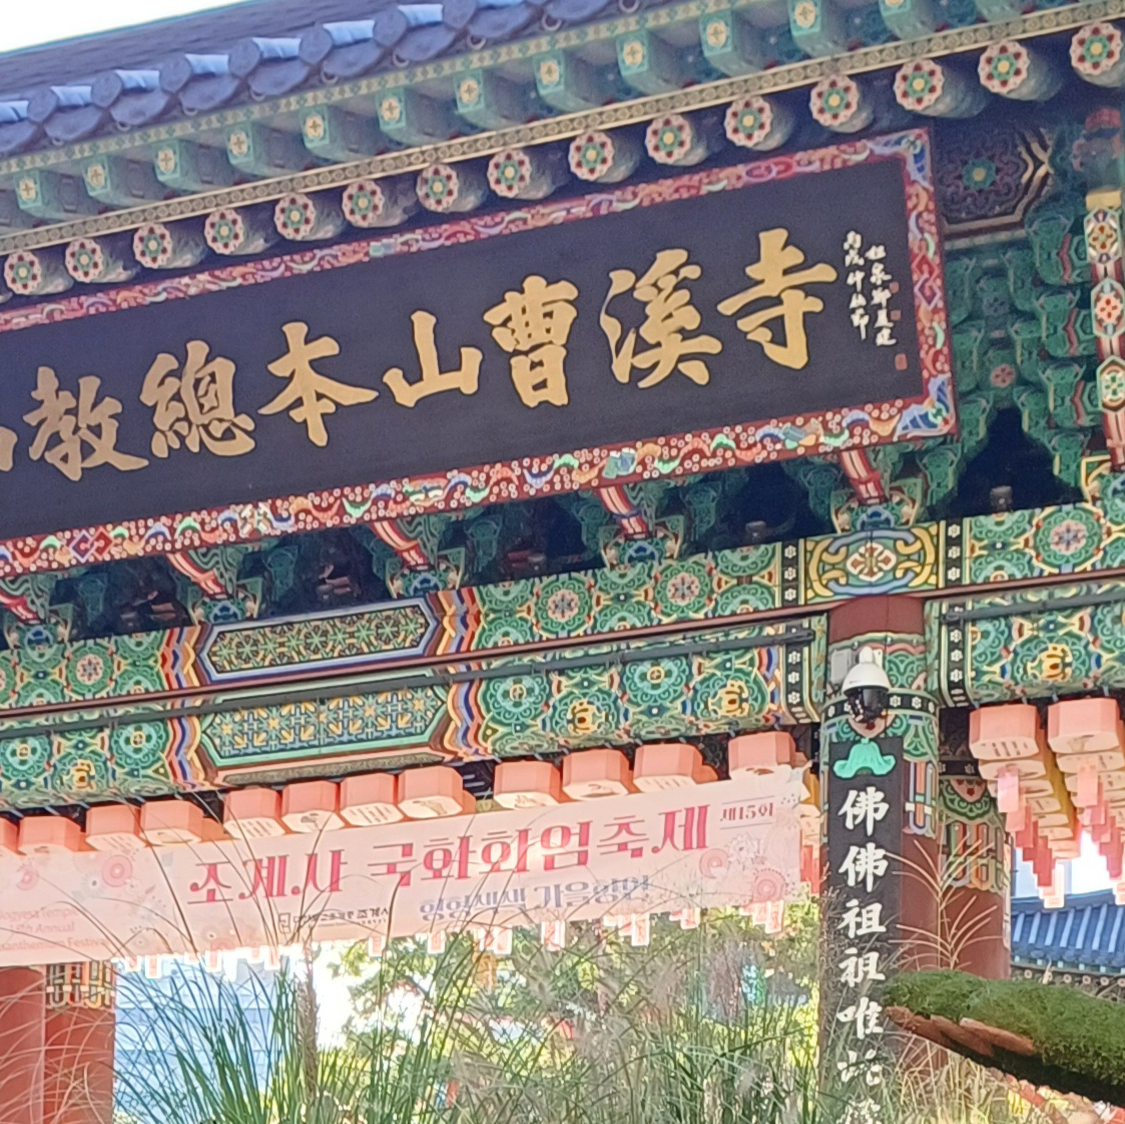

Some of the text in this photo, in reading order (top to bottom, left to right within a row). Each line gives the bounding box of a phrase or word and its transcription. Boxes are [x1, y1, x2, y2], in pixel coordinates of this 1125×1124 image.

[187, 801, 774, 904] 조계사 국화화엄축제 제15회
